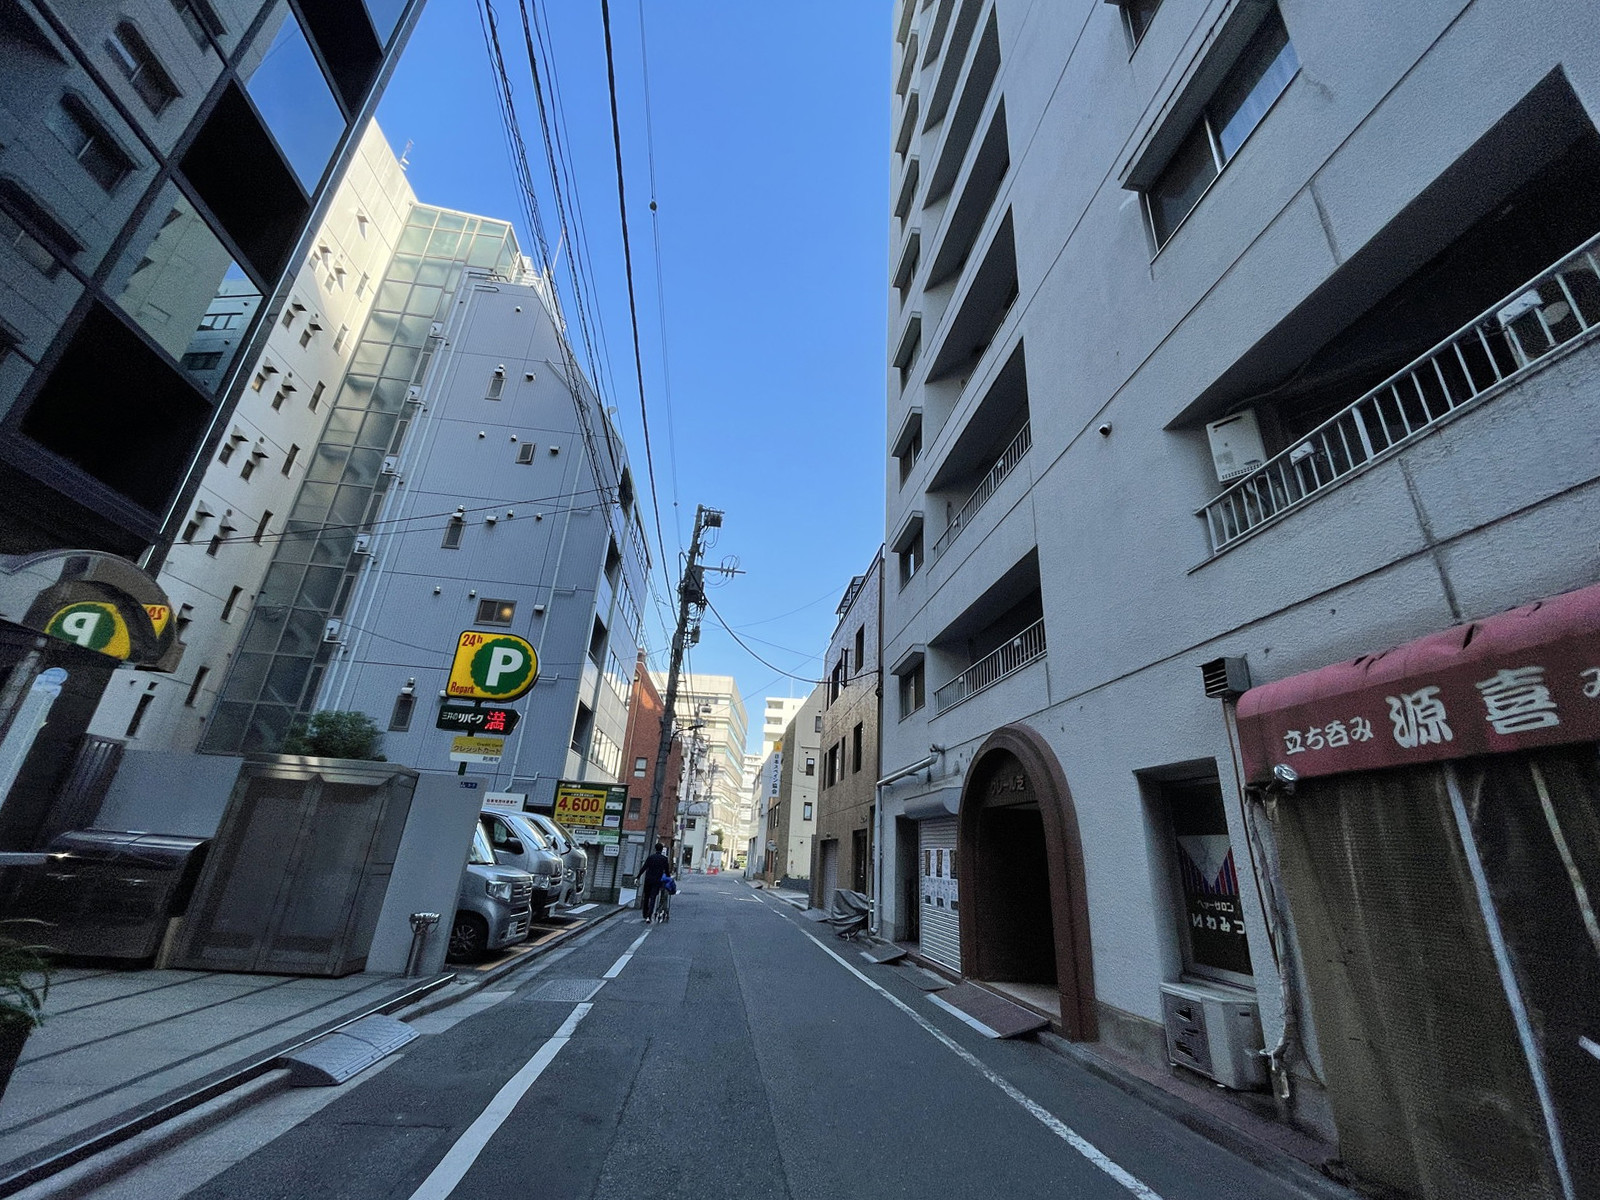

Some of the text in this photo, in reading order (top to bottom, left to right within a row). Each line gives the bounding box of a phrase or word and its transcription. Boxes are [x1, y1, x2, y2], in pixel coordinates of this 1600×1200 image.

[461, 634, 483, 647] 24h
[485, 646, 524, 687] P
[450, 681, 475, 695] Repark
[441, 711, 485, 724] 三井のリパーク
[484, 710, 507, 731] 満
[1283, 716, 1374, 756] 立ち呑み
[771, 753, 780, 795] 日本スペイン協会
[558, 796, 600, 813] 4,600
